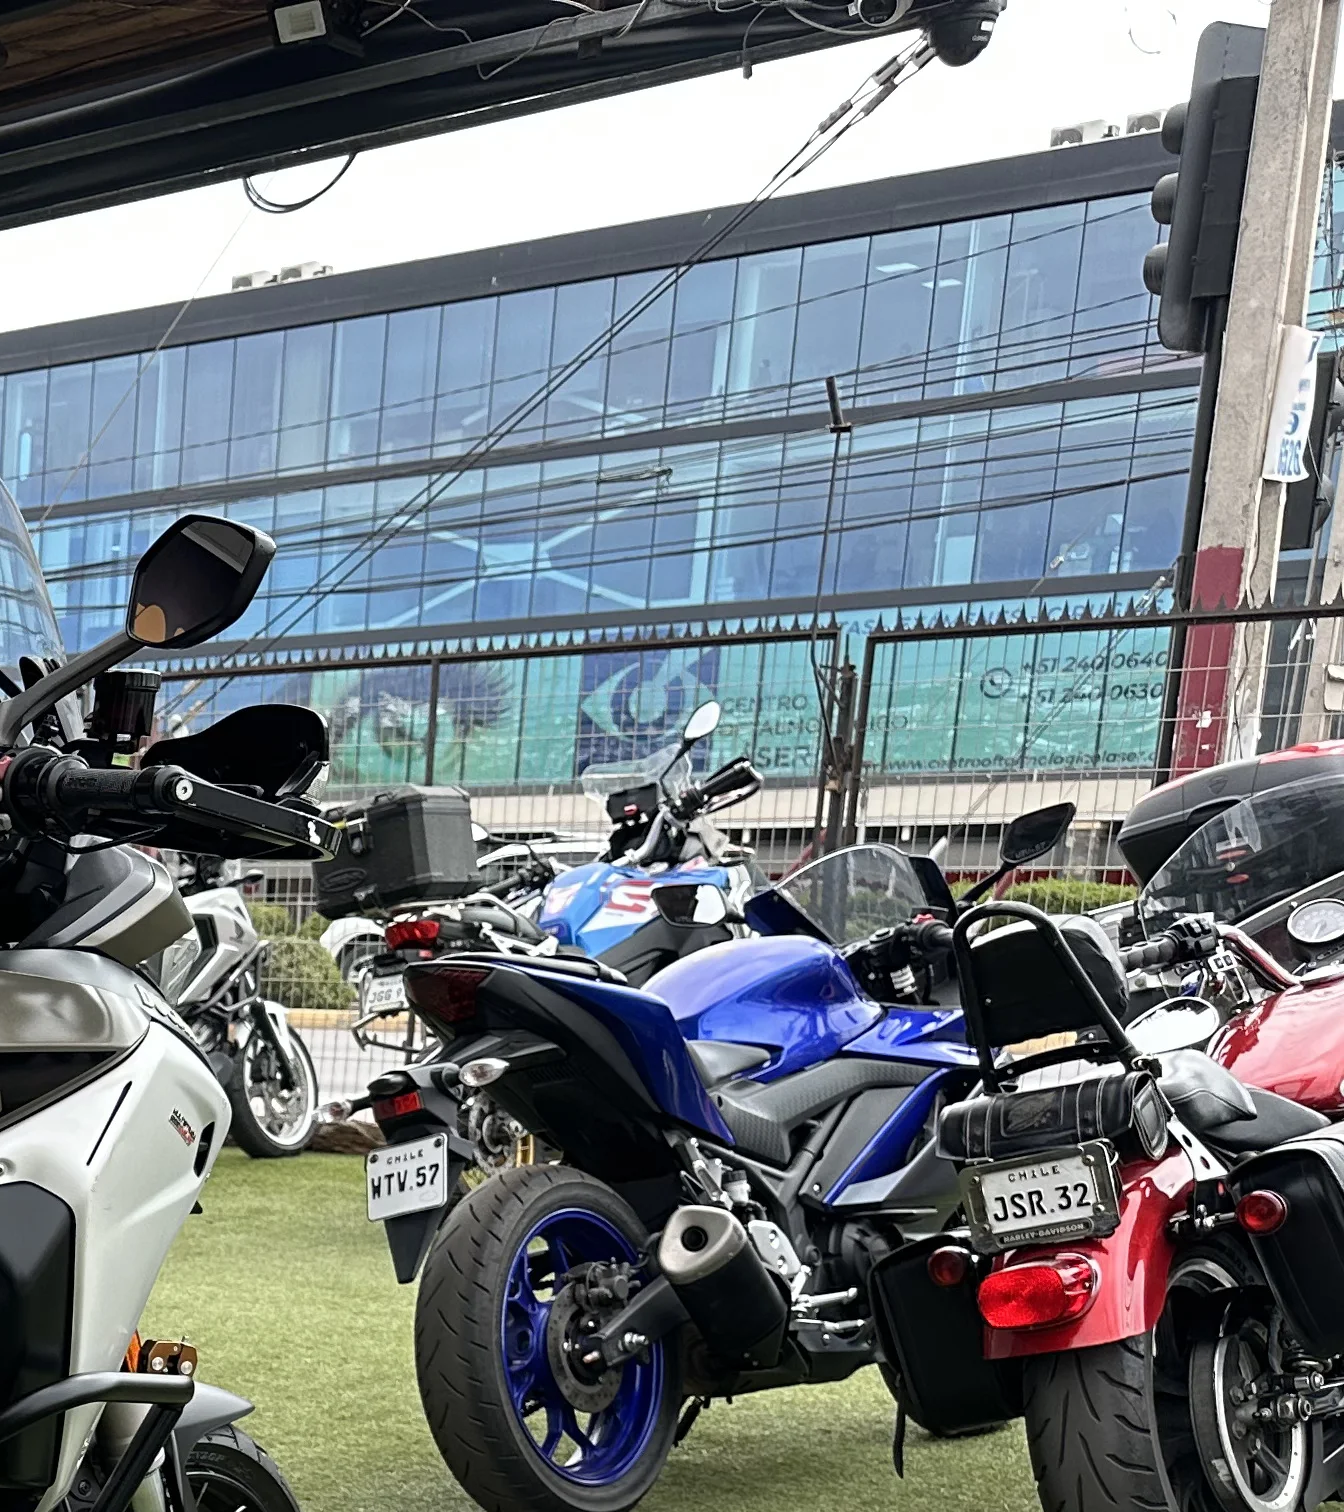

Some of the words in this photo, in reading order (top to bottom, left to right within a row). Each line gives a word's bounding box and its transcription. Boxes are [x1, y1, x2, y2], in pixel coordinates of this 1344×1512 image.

[386, 1149, 424, 1165] CHILE
[371, 1163, 440, 1200] WTV.57
[1008, 1164, 1060, 1183] CHILE
[993, 1182, 1091, 1222] JSR.32
[1002, 1222, 1085, 1244] HARLEY-DAVIDSON
